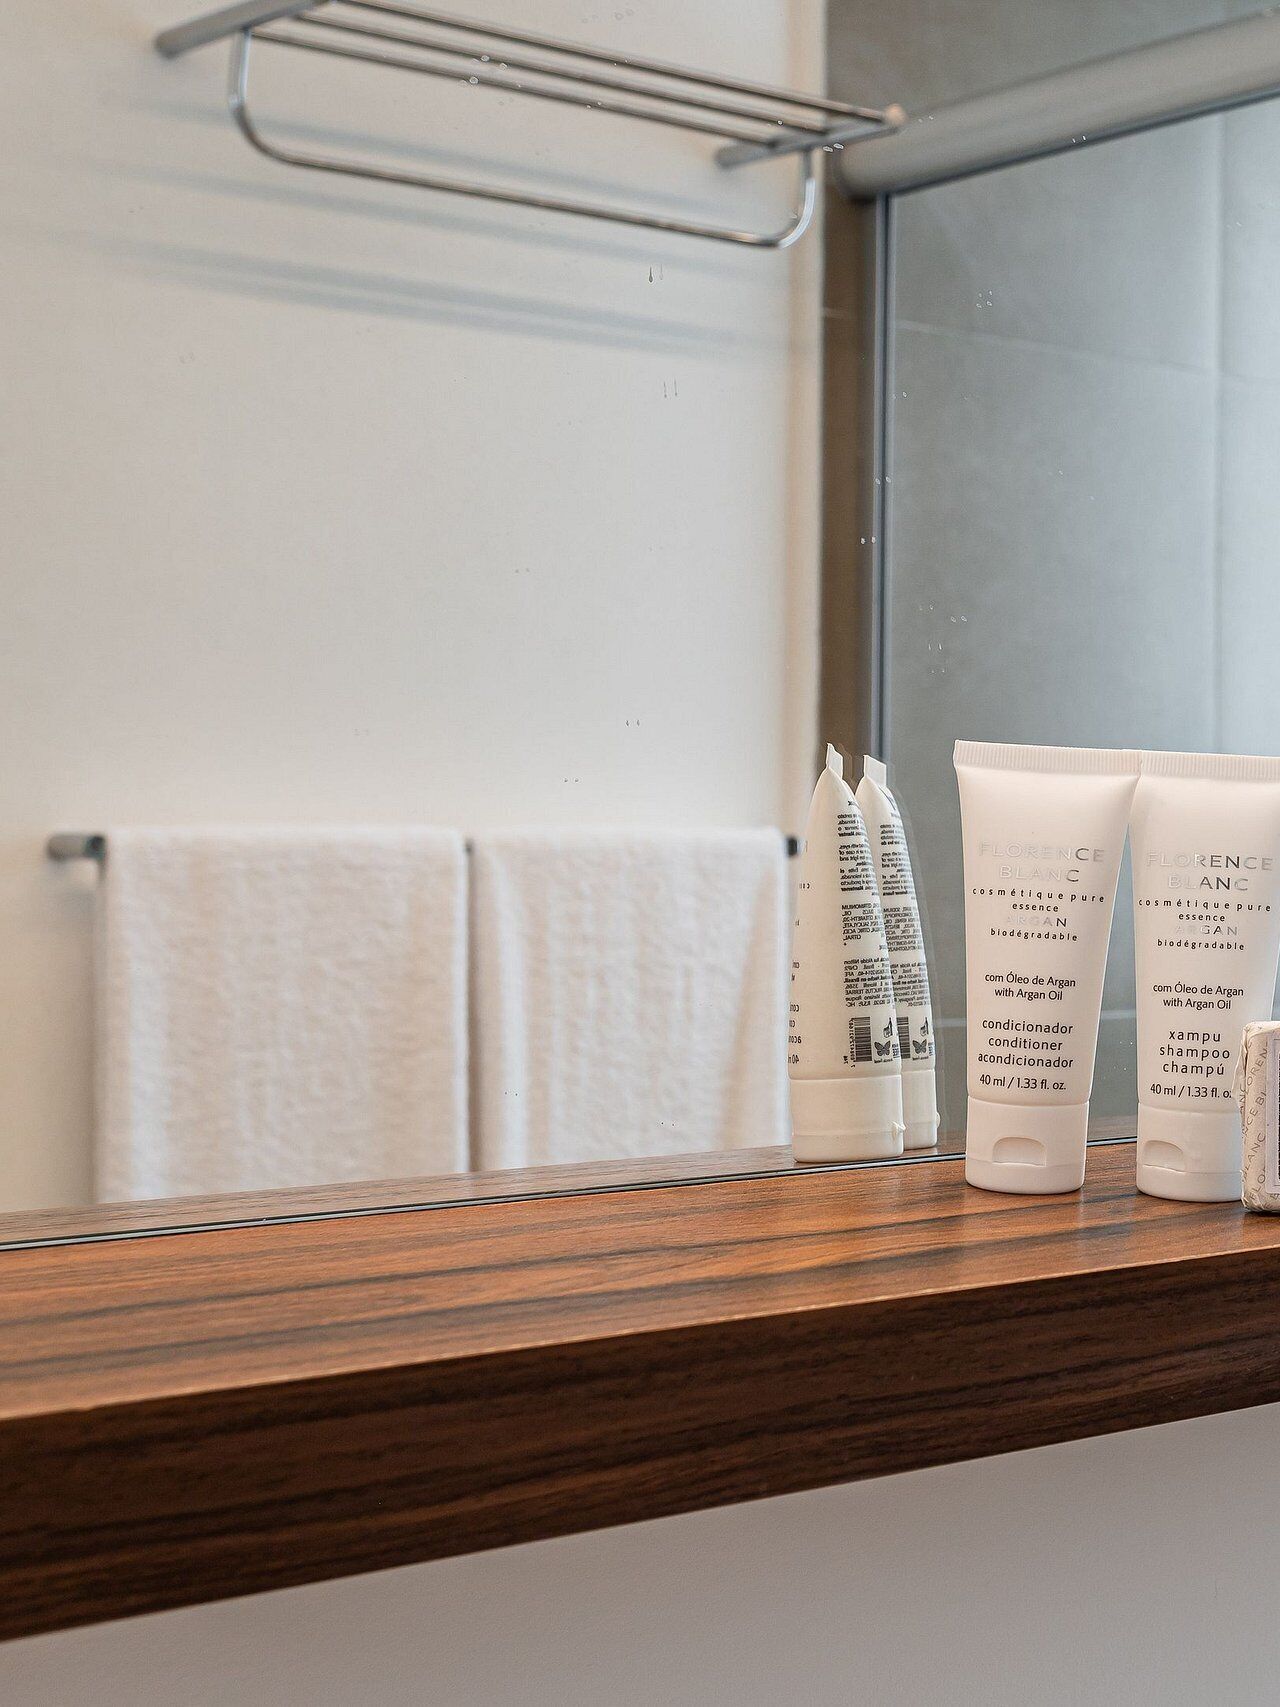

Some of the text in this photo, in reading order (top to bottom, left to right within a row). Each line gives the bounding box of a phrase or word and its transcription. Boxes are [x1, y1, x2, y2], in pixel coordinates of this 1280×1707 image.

[978, 840, 1105, 863] FLORENCE
[1145, 852, 1274, 872] FLORENCE
[999, 865, 1080, 883] BLANC
[1167, 873, 1249, 892] BLANC
[972, 886, 1105, 905] cosmétique pure
[1012, 902, 1059, 913] essence
[1138, 897, 1272, 915] cosmétique pure
[1178, 911, 1226, 922] essence
[990, 928, 1078, 943] biodégradable
[1157, 938, 1245, 953] biodégradable
[985, 970, 1076, 989] com Óleo de Argan
[994, 986, 1063, 1002] with Argan Oil
[1153, 981, 1244, 1000] com Óleo de Argan
[1163, 997, 1232, 1012] with Argan Oil
[982, 1017, 1074, 1036] condicionador
[988, 1035, 1063, 1052] conditioner
[1168, 1028, 1221, 1046] xampu
[977, 1051, 1074, 1070] acondicionador
[1159, 1044, 1230, 1062] shampoo
[1162, 1060, 1225, 1079] champú
[979, 1074, 992, 1086] 40
[993, 1074, 1006, 1087] ml
[1016, 1076, 1037, 1090] 1.33
[1039, 1078, 1050, 1091] fl.
[1052, 1081, 1067, 1091] oz.
[1150, 1083, 1162, 1095] 40
[1163, 1084, 1176, 1097] ml
[1187, 1086, 1208, 1099] 1.33
[1209, 1087, 1221, 1100] fl.
